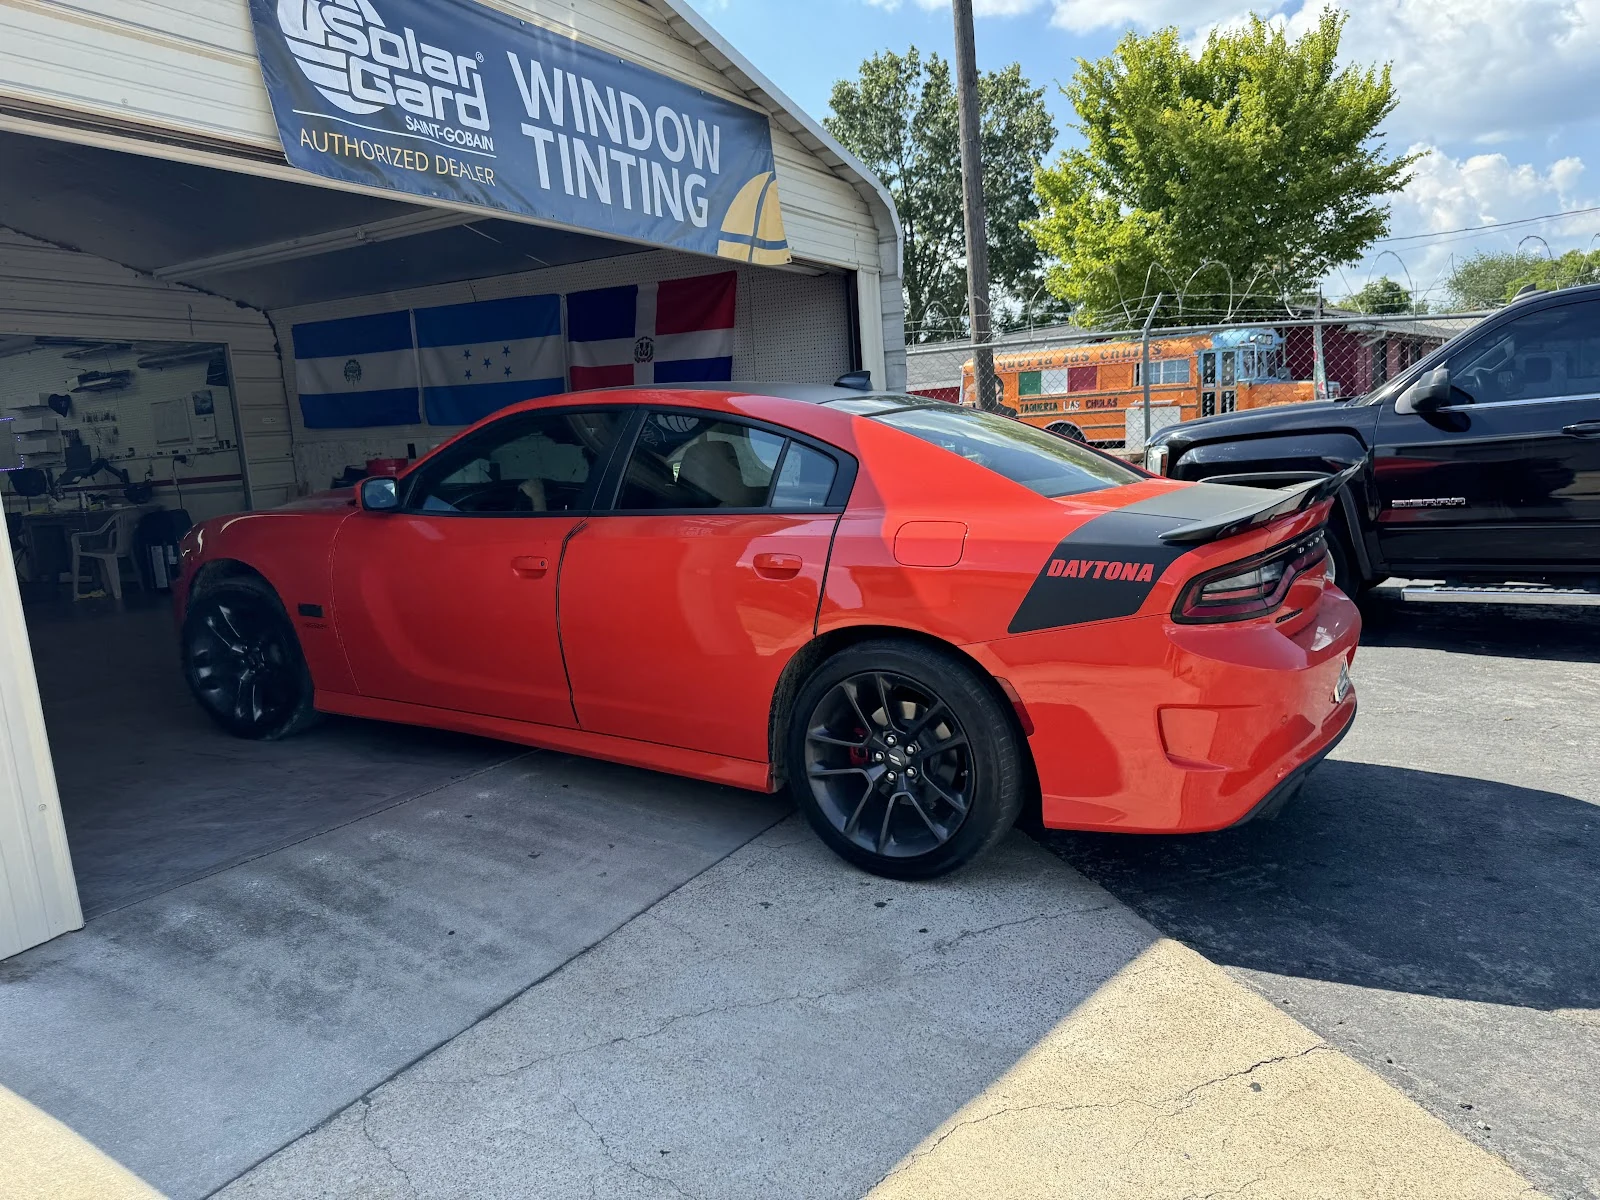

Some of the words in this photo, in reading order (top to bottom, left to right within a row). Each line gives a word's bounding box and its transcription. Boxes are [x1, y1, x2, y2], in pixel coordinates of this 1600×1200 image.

[321, 5, 478, 89] Solar
[349, 56, 490, 131] Gard
[506, 51, 720, 175] WINDOW
[300, 127, 429, 172] AUTHORIZED
[435, 155, 496, 187] DEALER
[405, 115, 494, 152] SAINT-GOBAIN
[520, 122, 709, 228] TINTING
[1019, 401, 1058, 414] TAQUERIA
[1062, 400, 1080, 411] LAS
[1046, 558, 1155, 583] DAYTONA
